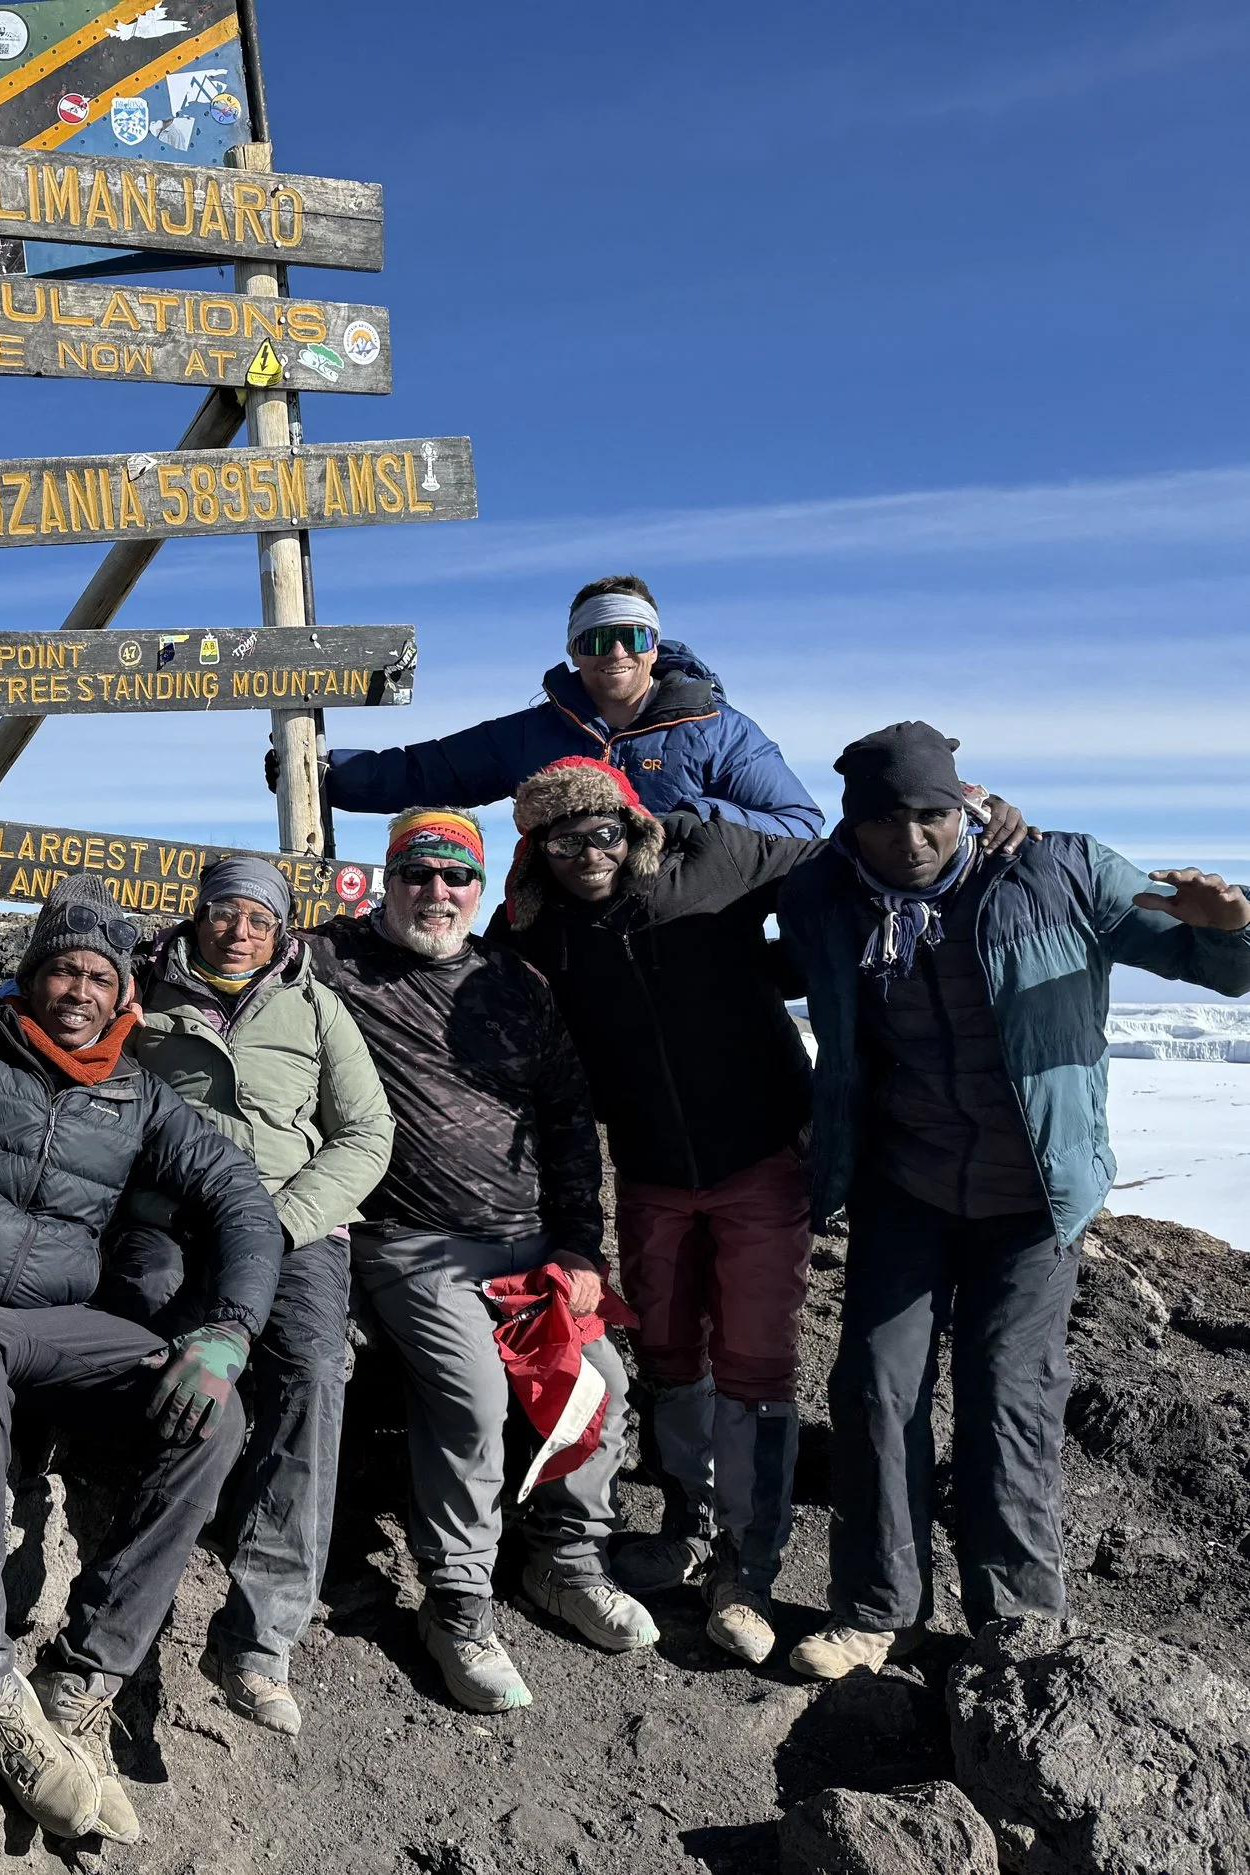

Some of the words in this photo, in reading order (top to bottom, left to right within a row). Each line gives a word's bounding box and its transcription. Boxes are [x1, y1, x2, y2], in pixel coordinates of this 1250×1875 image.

[56, 339, 154, 376] NOW
[183, 348, 236, 378] AT
[156, 456, 309, 526] 5895M
[323, 451, 433, 517] AMSL
[122, 645, 137, 660] 47
[232, 668, 370, 697] MOUNTAIN
[642, 759, 663, 770] OR
[341, 865, 365, 879] CANADA
[105, 876, 200, 914] ONDER
